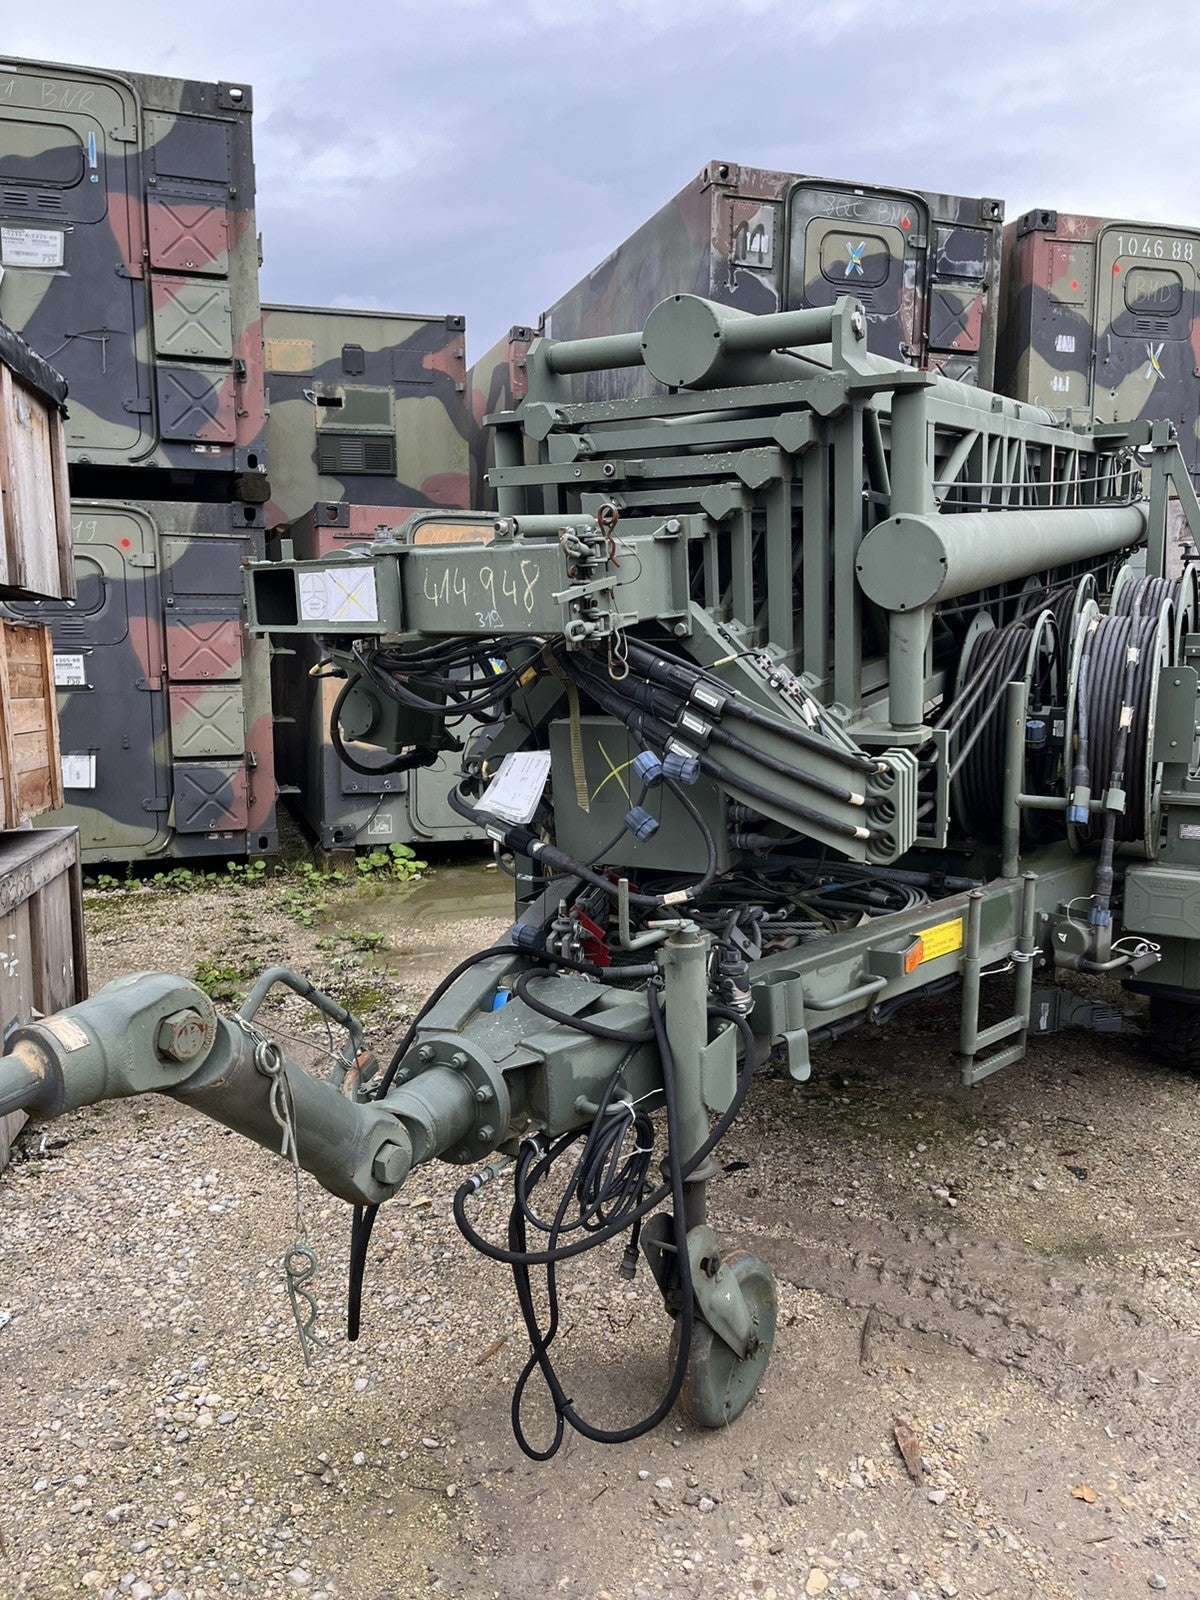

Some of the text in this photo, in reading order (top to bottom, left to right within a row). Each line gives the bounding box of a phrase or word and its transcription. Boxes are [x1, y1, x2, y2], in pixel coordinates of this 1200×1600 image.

[1117, 235, 1194, 261] 1046 88
[423, 560, 541, 614] 414 948
